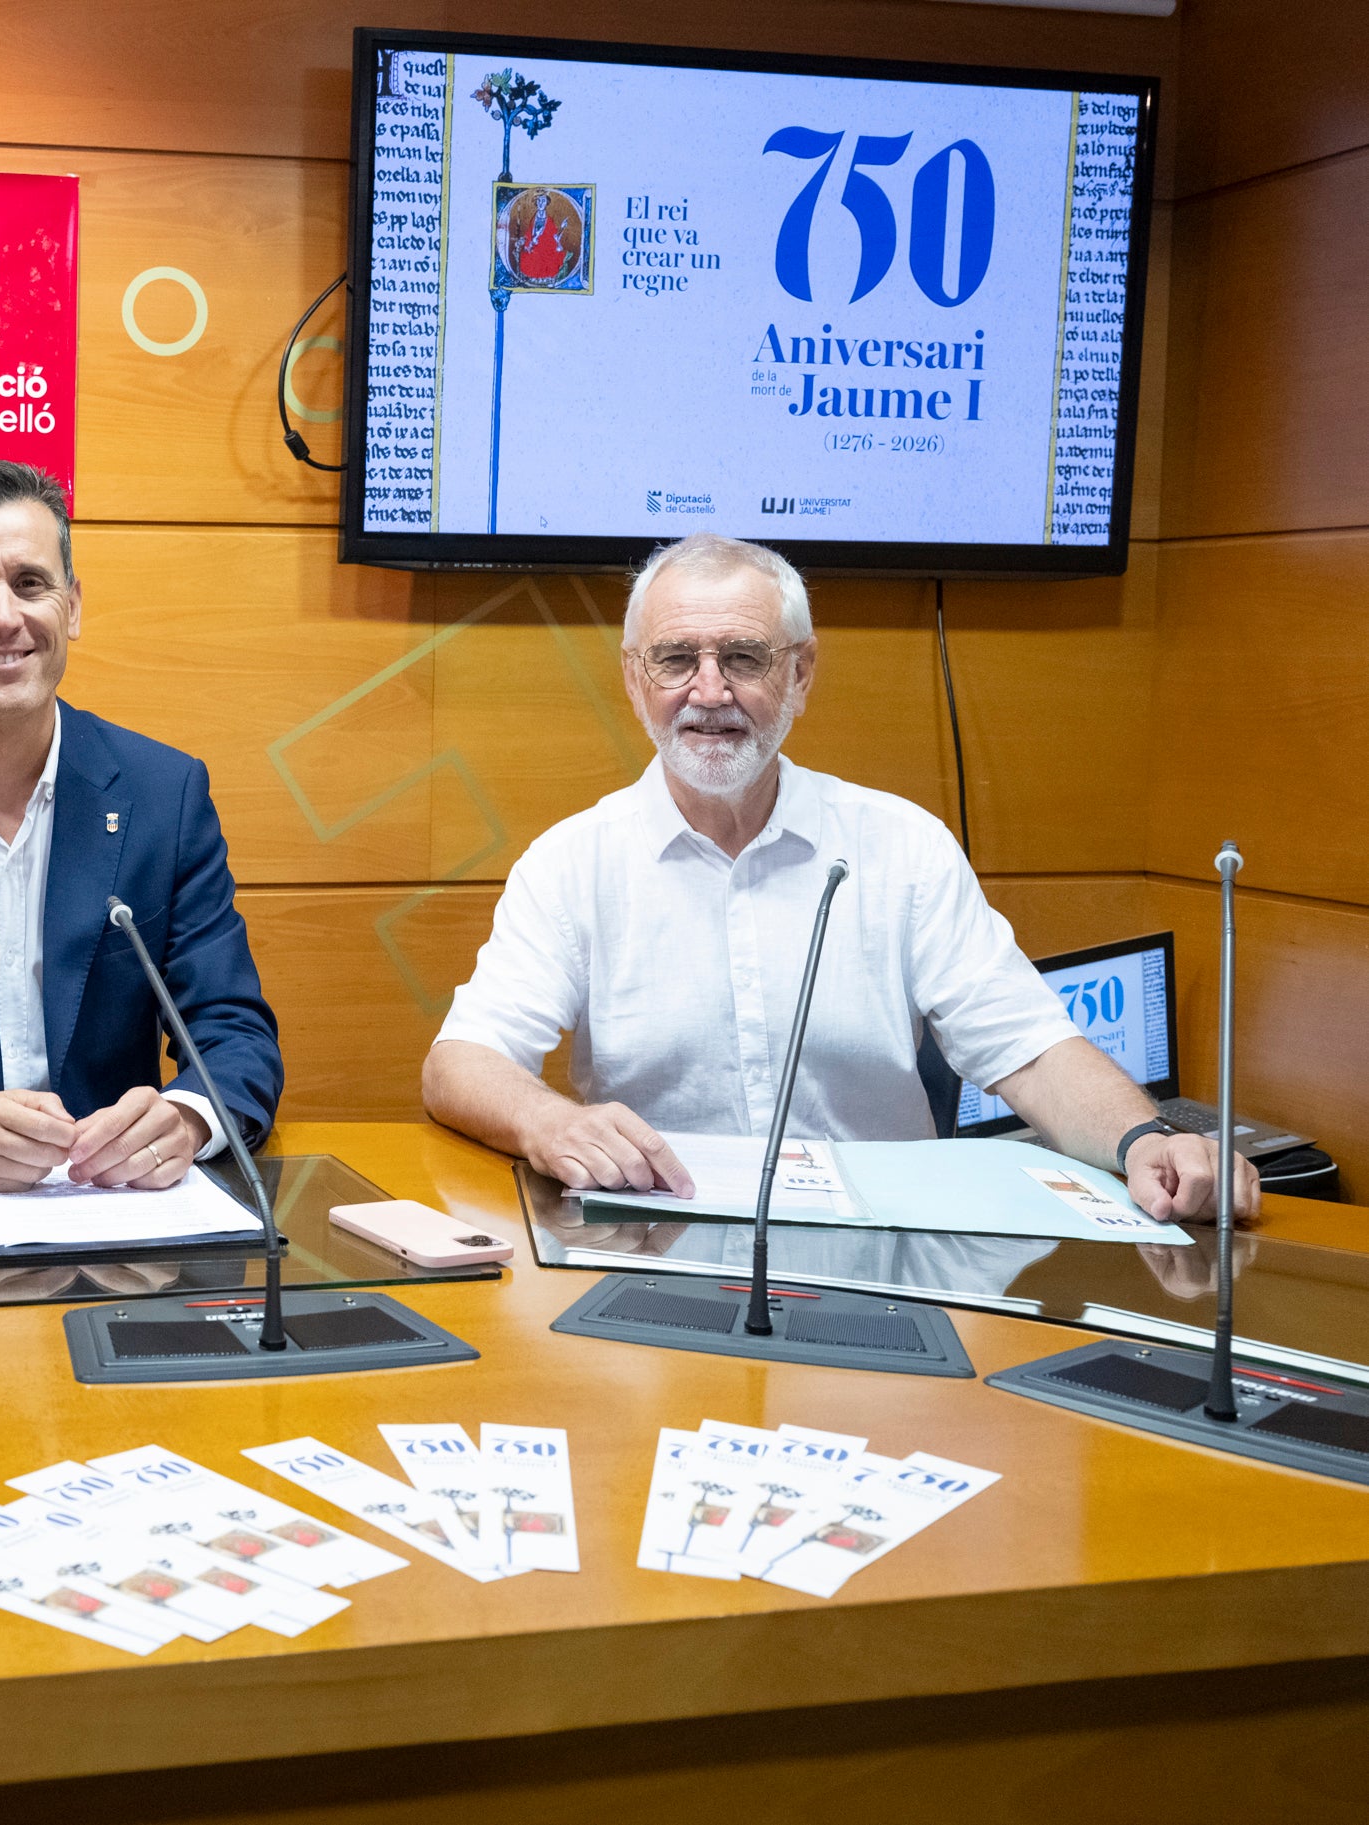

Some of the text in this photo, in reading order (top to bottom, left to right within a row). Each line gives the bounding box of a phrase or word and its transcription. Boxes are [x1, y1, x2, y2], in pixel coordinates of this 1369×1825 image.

[626, 196, 688, 221] El rei
[762, 126, 996, 308] 750
[623, 226, 700, 249] que va
[622, 250, 721, 270] crear un
[622, 273, 689, 297] regne
[751, 323, 986, 370] Aniversari
[752, 369, 777, 382] de la
[751, 384, 792, 396] mort de
[788, 373, 986, 421] Jaume I
[824, 431, 873, 454] (1276
[891, 433, 945, 455] 2026)
[665, 504, 716, 515] de Castelló
[666, 493, 712, 505] Diputació
[799, 498, 851, 507] UNIVERSITAT
[799, 506, 827, 515] JAUME
[1059, 975, 1125, 1028] 750
[397, 1439, 466, 1454] 750
[492, 1438, 557, 1456] 750
[707, 1434, 769, 1457] 750
[782, 1438, 849, 1461] 750
[121, 1461, 192, 1484] 750
[274, 1453, 345, 1475] 750
[44, 1476, 114, 1501] 750
[897, 1465, 970, 1492] 750
